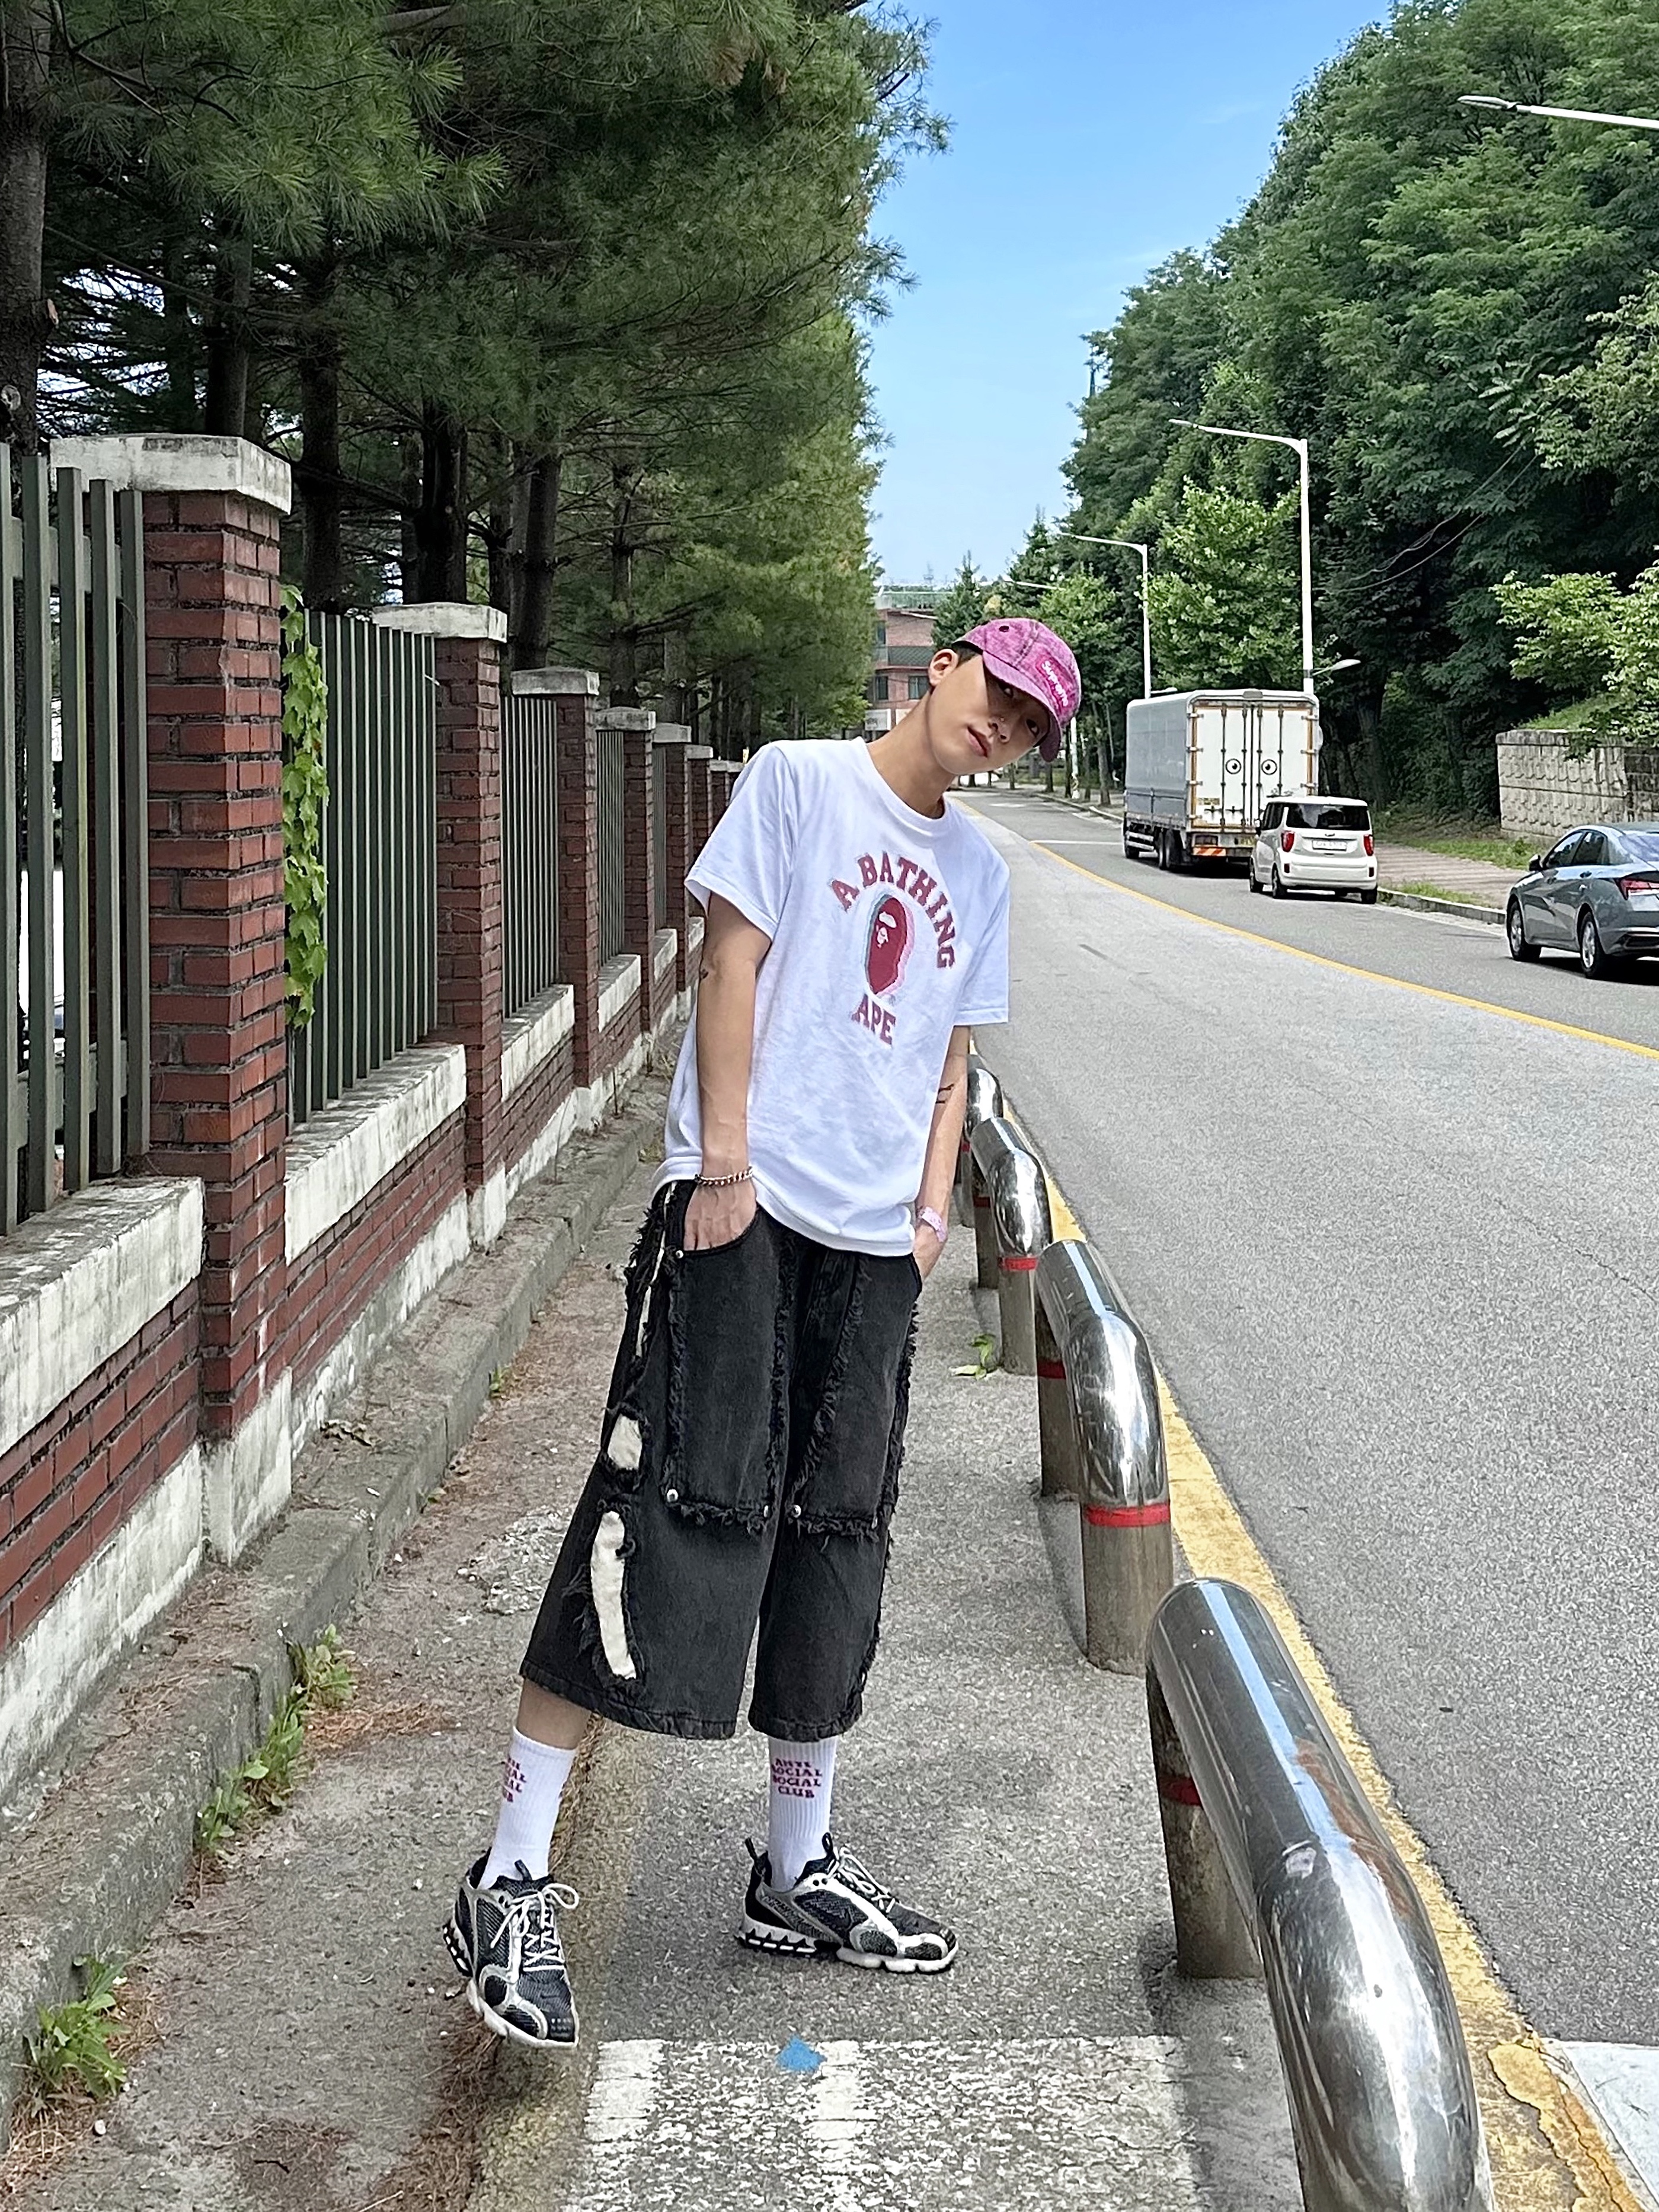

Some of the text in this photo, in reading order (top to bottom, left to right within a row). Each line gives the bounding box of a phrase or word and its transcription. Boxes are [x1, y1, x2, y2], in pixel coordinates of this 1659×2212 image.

[831, 851, 955, 968] A BATHING
[851, 993, 896, 1045] APE
[771, 1764, 822, 1777] SOCIAL
[772, 1775, 821, 1787] SOCIAL
[778, 1786, 814, 1798] CLUB
